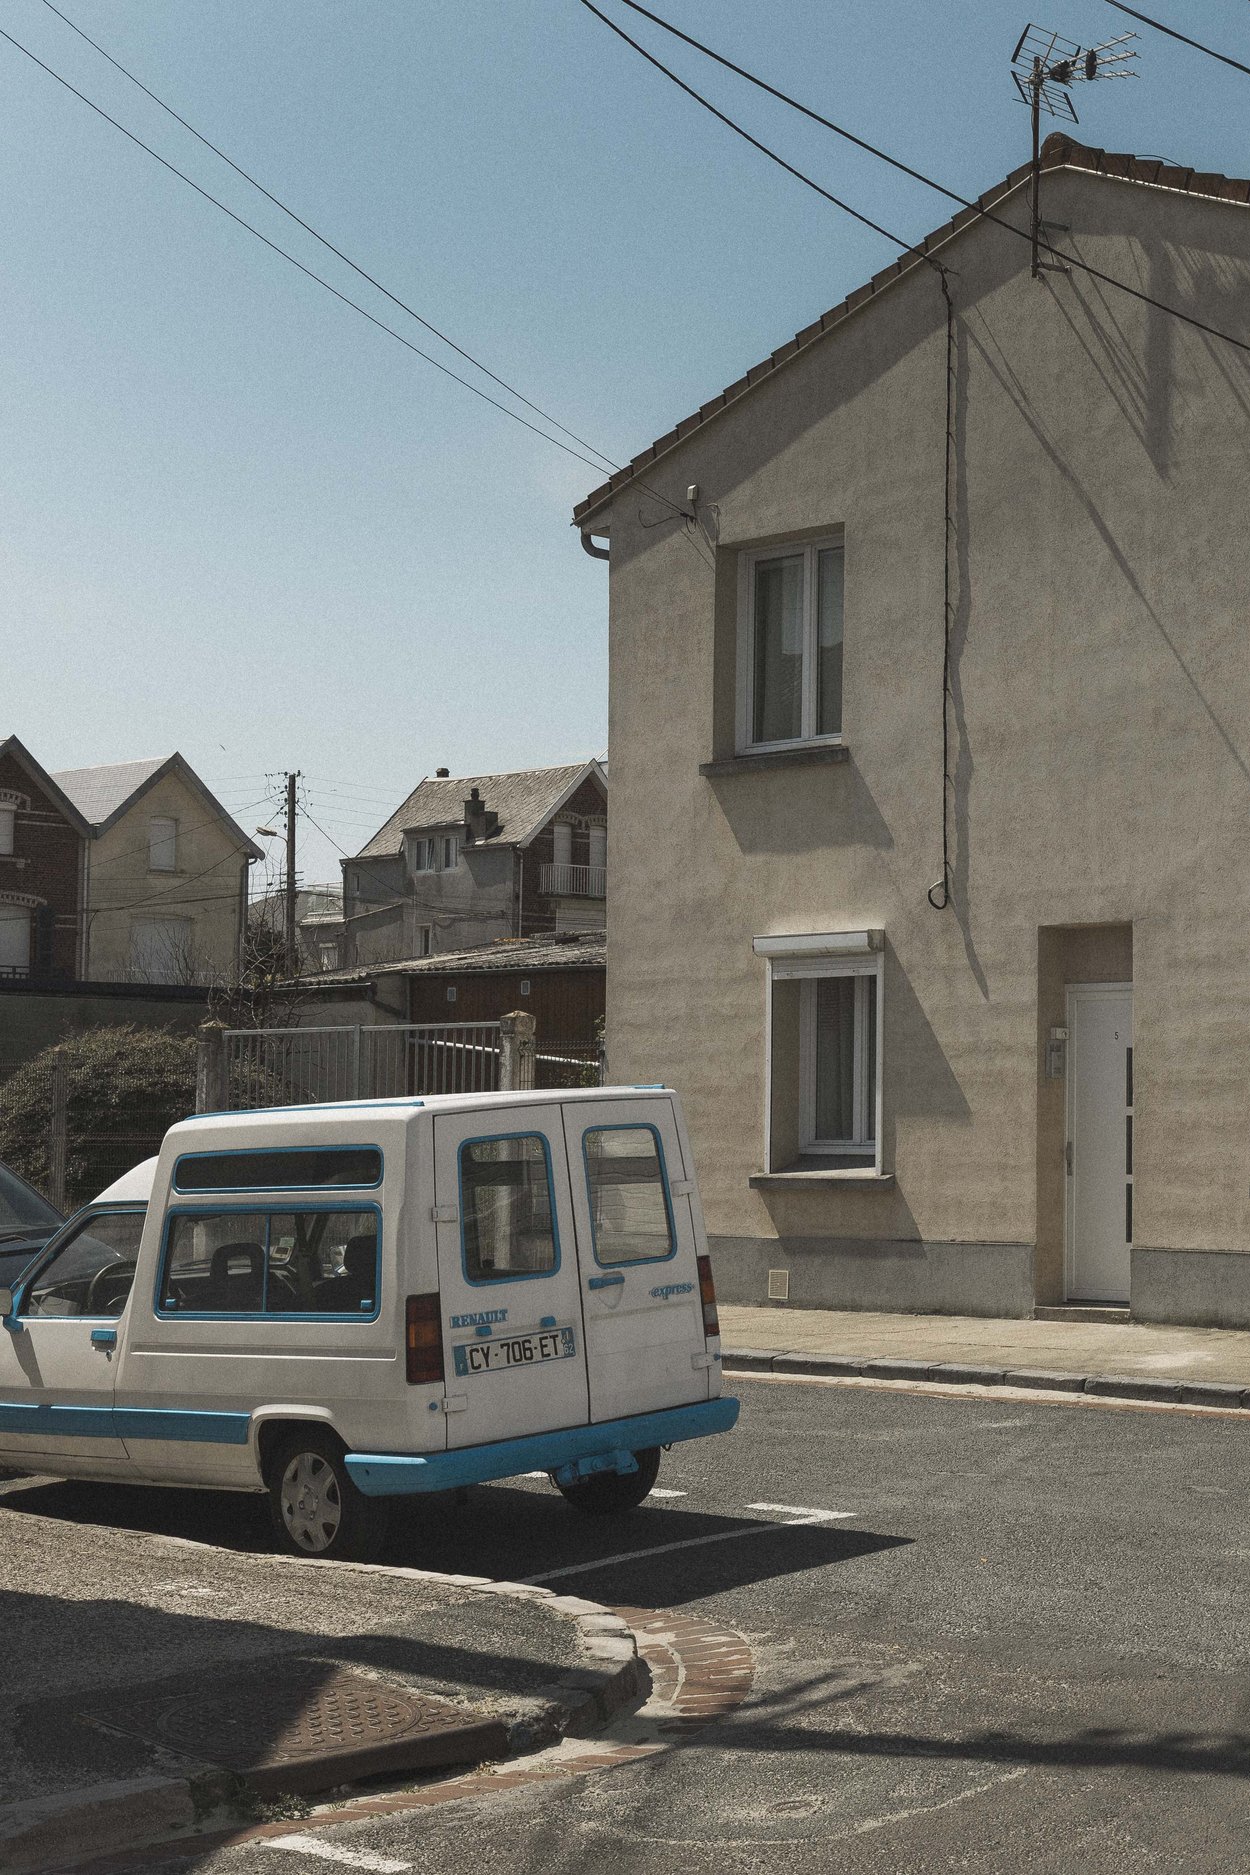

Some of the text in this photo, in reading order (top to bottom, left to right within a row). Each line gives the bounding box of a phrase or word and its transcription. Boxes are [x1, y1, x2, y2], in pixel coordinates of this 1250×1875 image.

[1114, 1031, 1119, 1040] 5
[449, 1308, 508, 1329] RENAULT
[562, 1343, 574, 1354] 62
